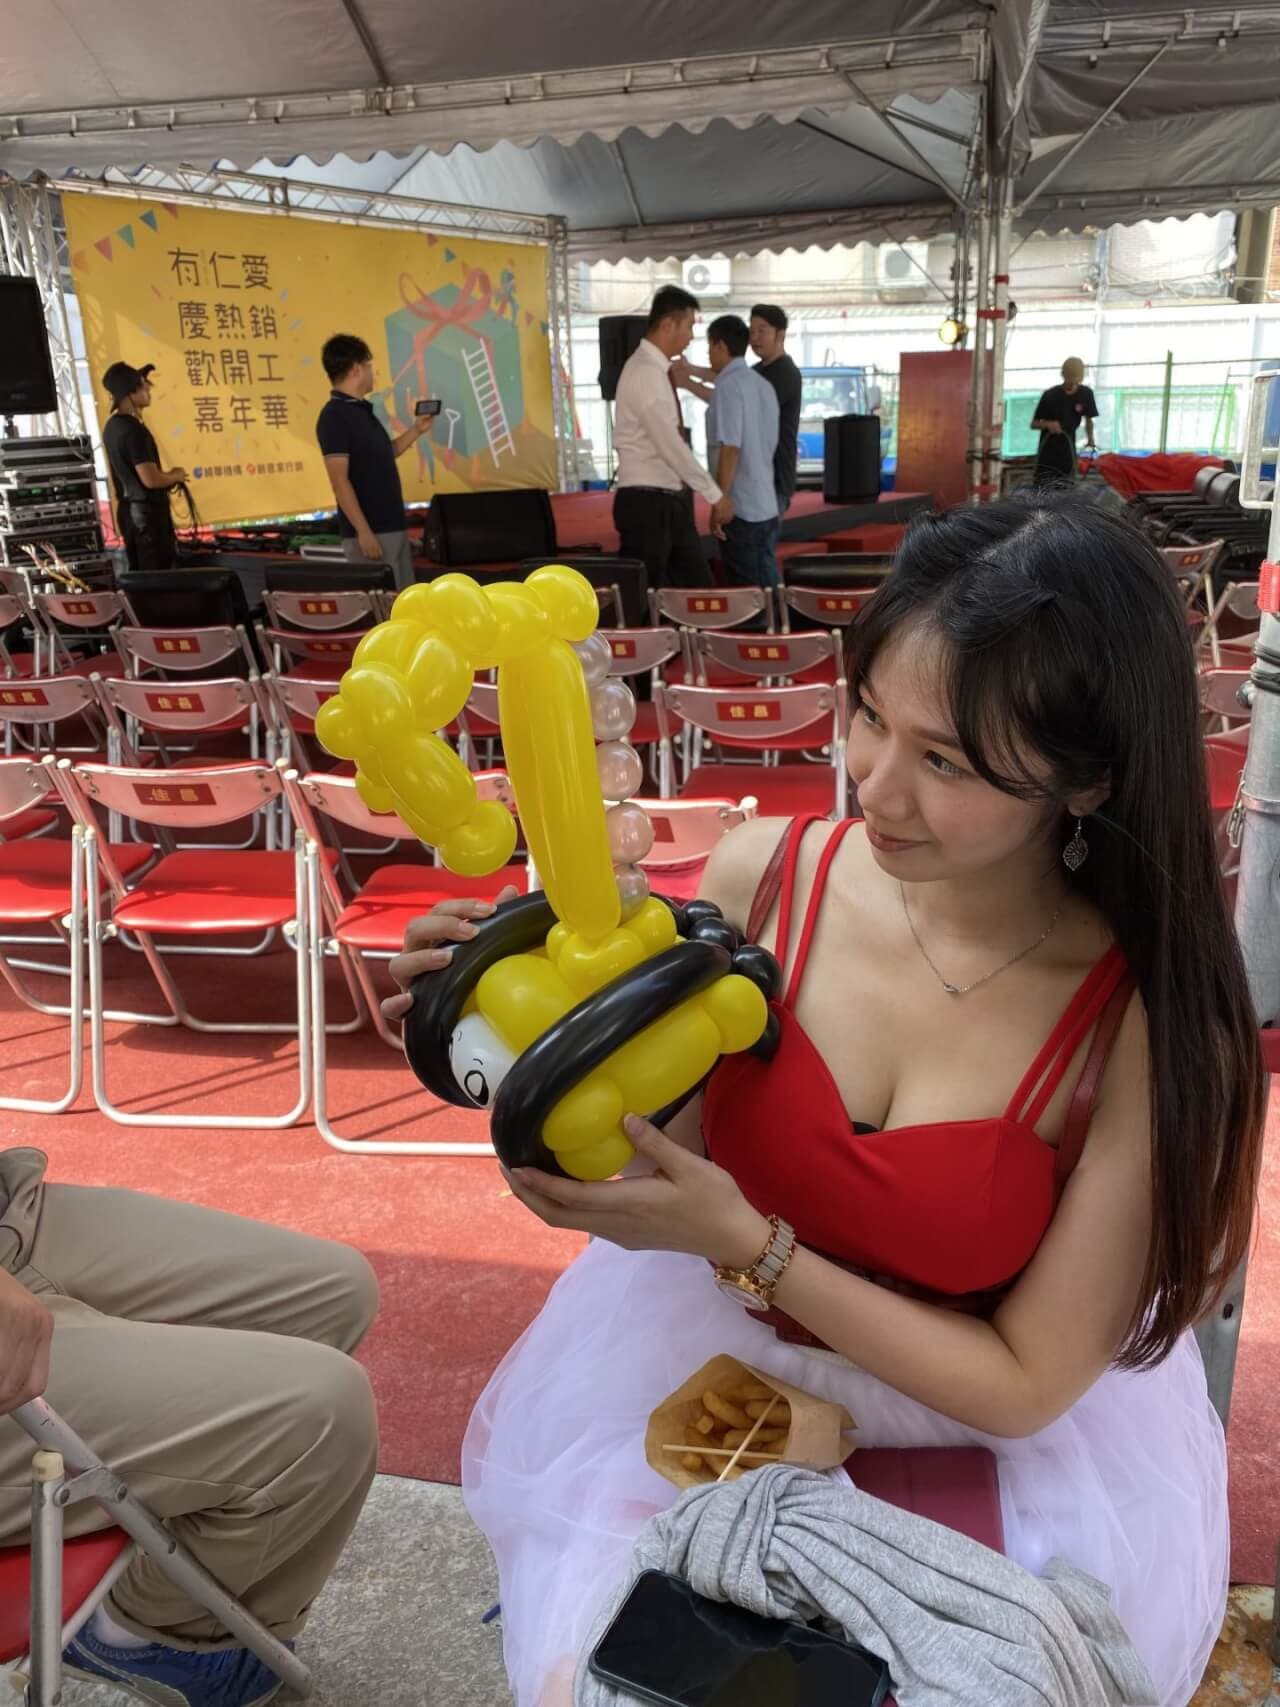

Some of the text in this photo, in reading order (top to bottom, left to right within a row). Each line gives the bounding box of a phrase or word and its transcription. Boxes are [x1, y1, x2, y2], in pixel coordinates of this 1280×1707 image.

[178, 301, 278, 340] 慶熱銷
[184, 349, 284, 387] 歡開工
[193, 395, 289, 433] 嘉年華
